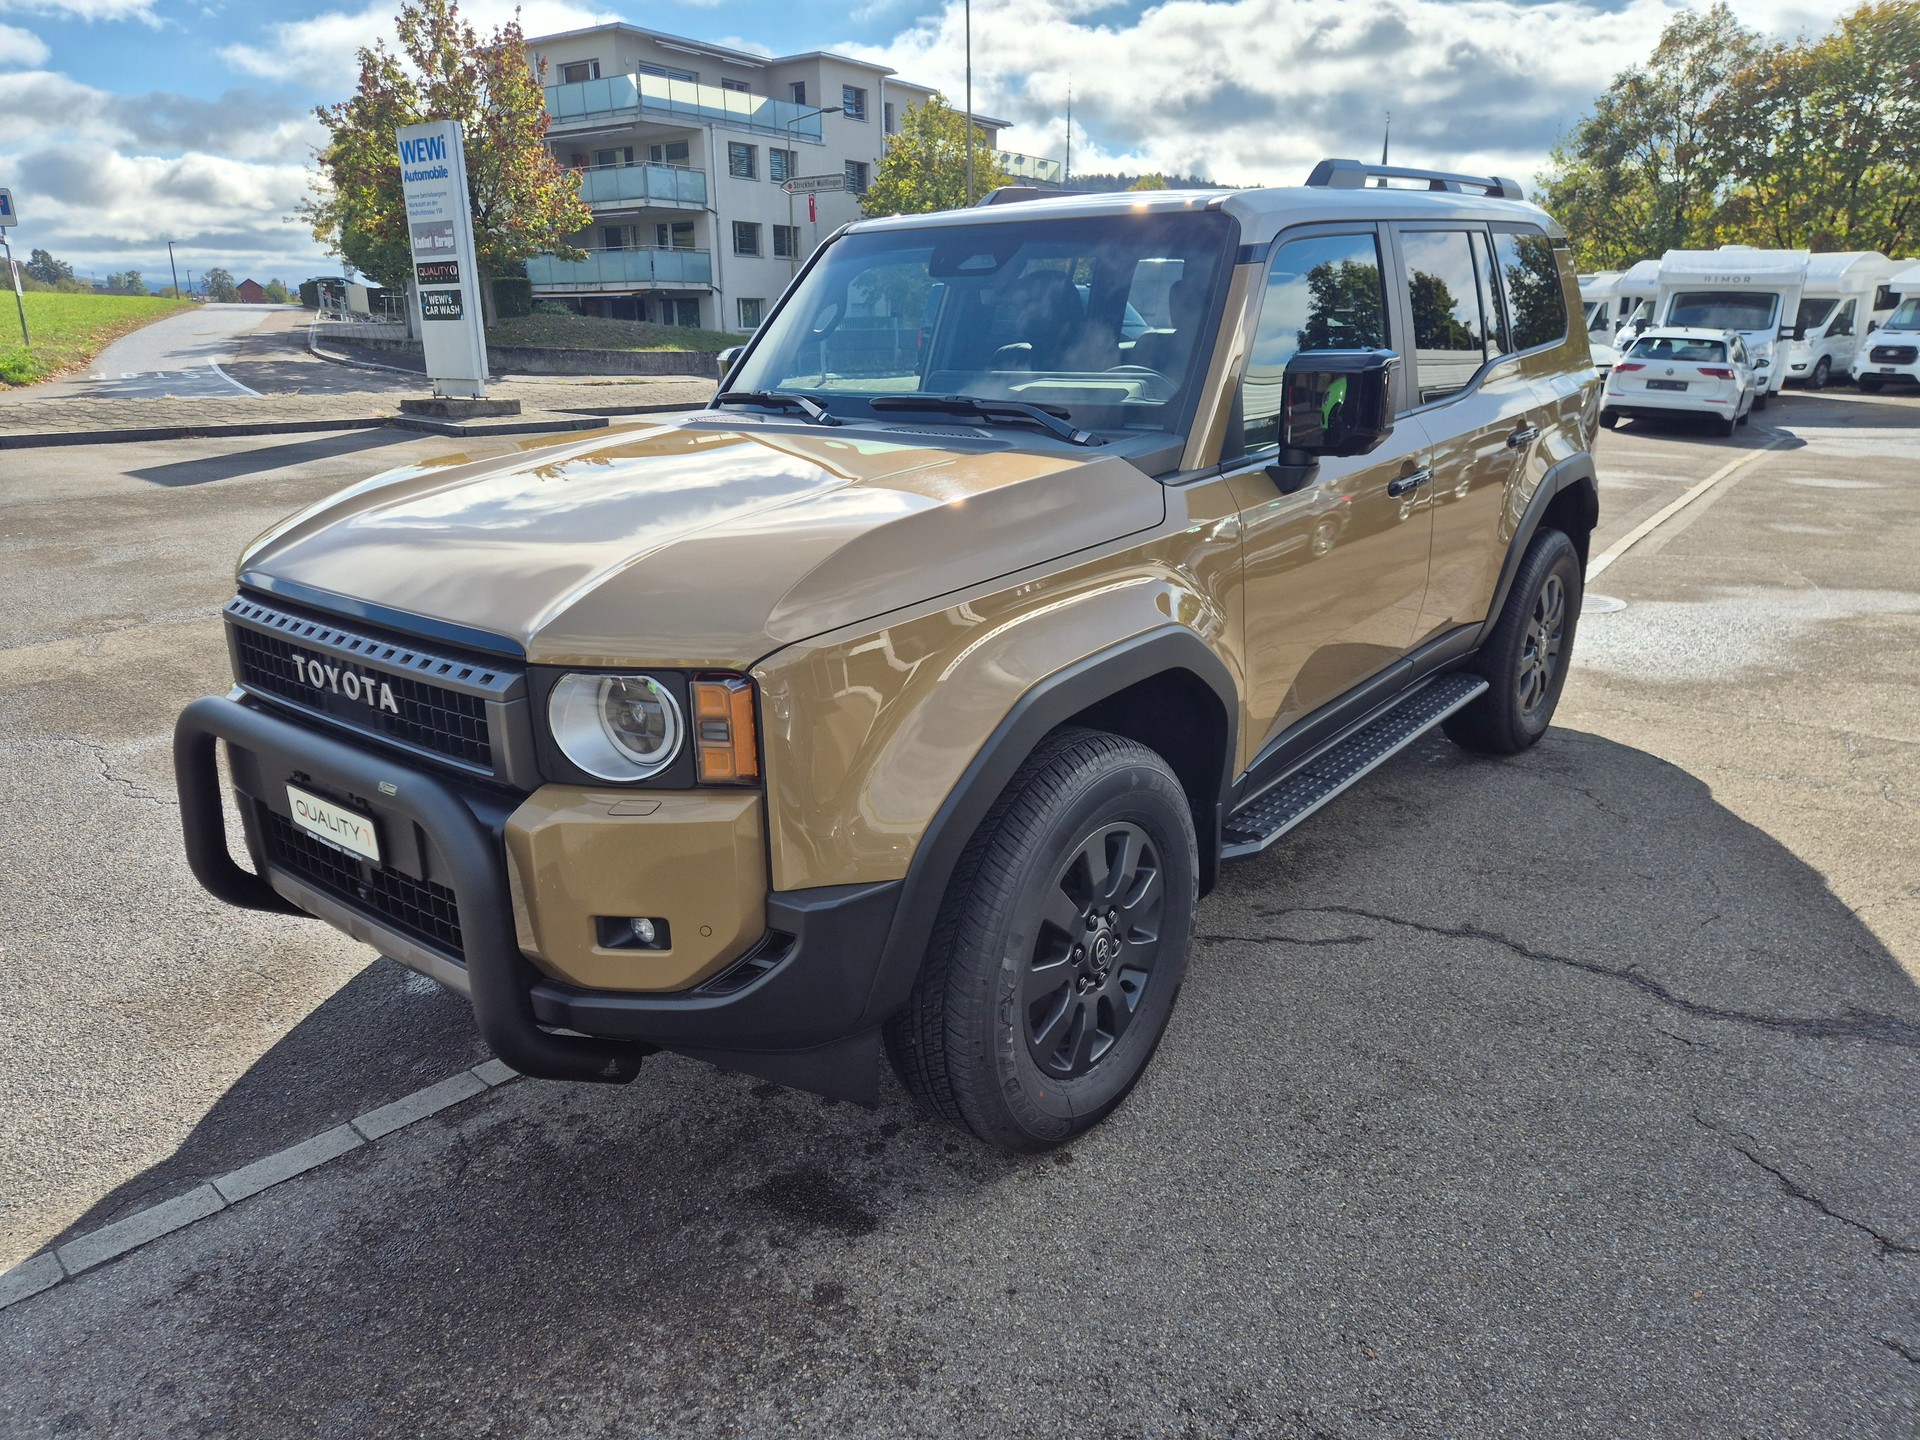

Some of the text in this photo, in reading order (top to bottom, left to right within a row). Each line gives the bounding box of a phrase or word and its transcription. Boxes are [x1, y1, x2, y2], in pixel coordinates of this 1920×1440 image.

[399, 134, 446, 165] WEWi
[404, 165, 448, 182] Automobile
[793, 180, 815, 189] Strickhof
[418, 266, 449, 276] QUALITY
[1704, 276, 1751, 284] RIMOR
[425, 305, 460, 315] CAR WASH
[89, 372, 201, 381] STOP
[292, 654, 399, 714] TOYOTA
